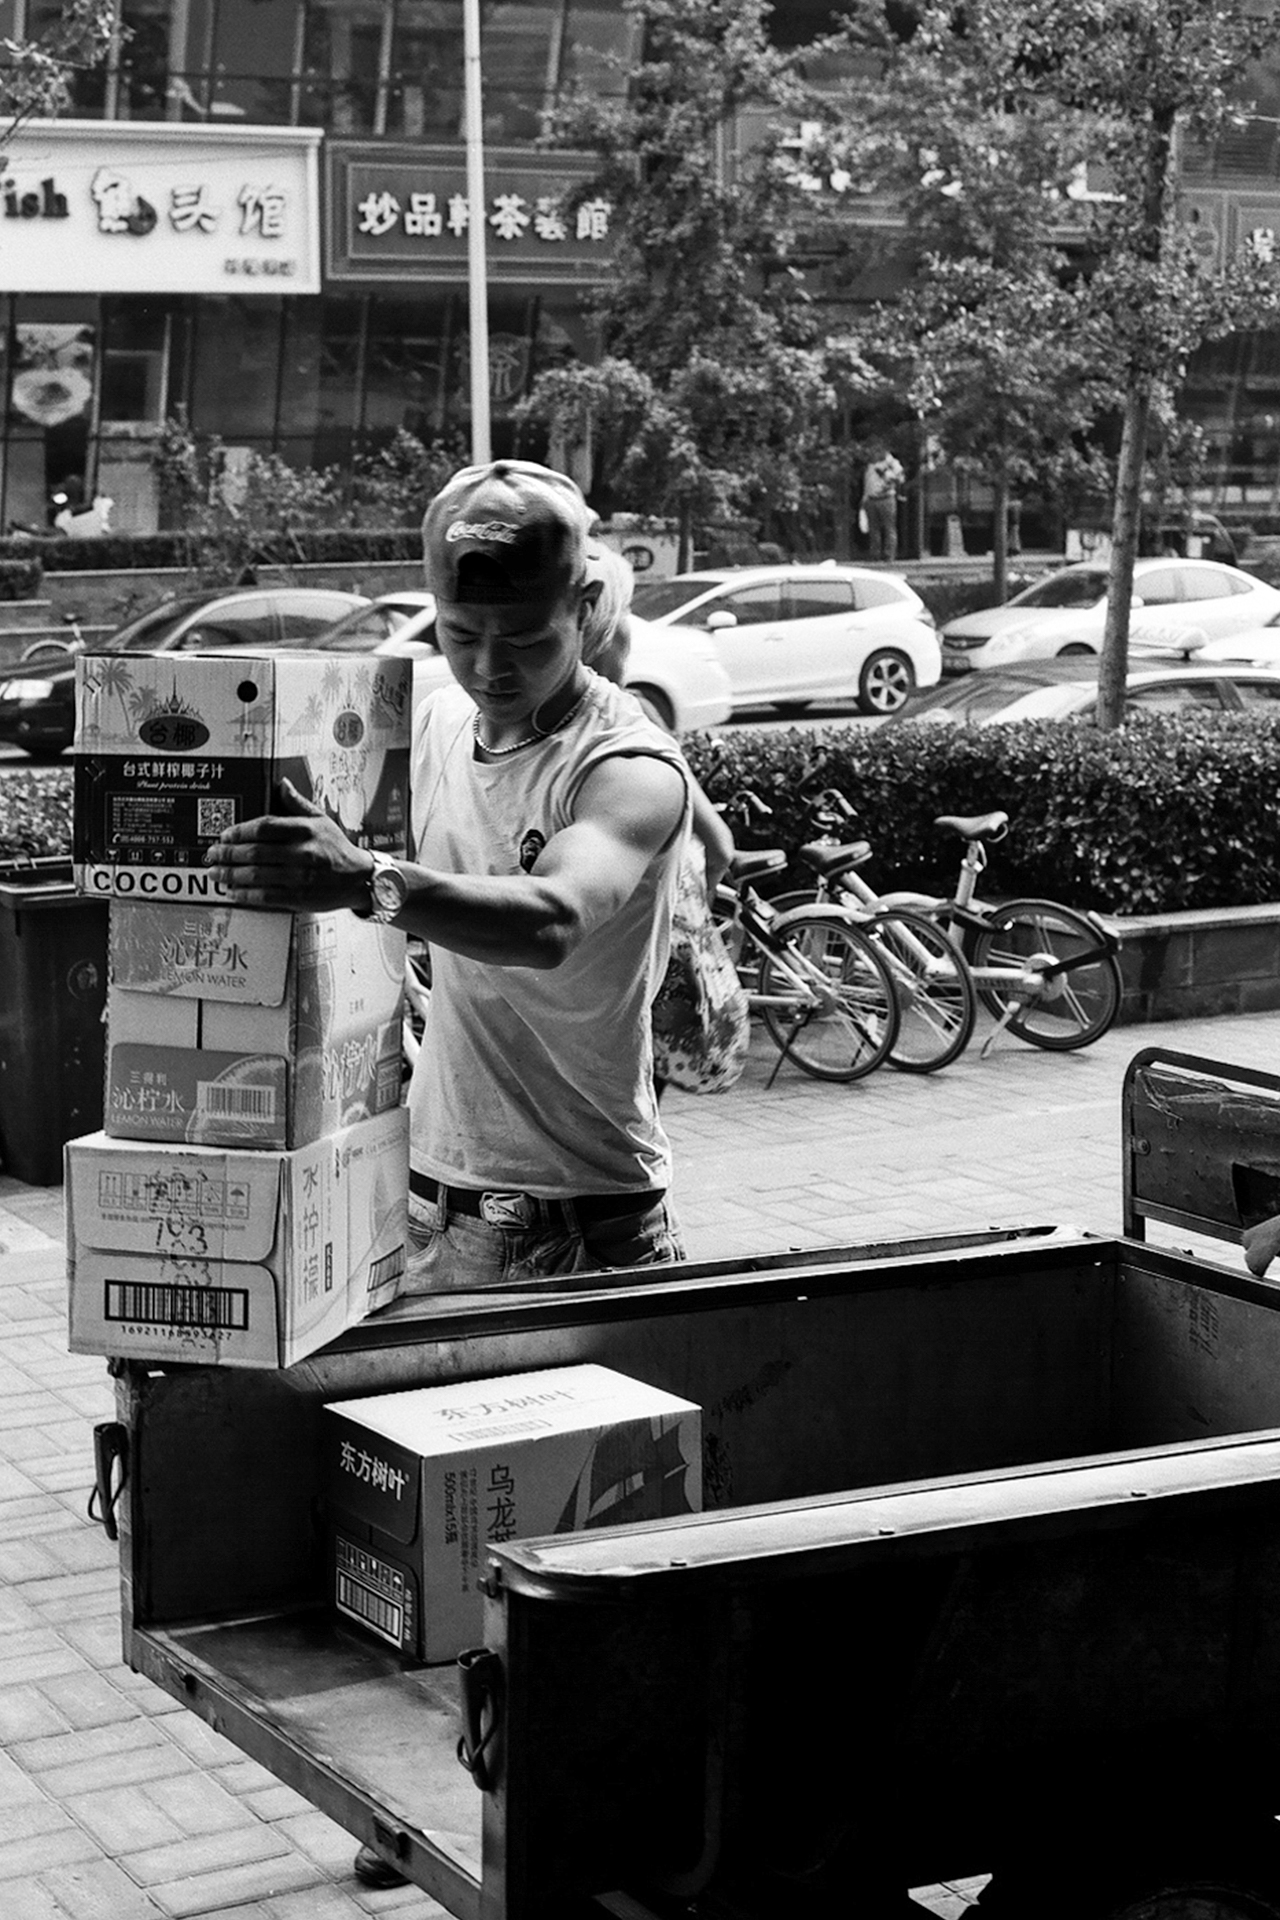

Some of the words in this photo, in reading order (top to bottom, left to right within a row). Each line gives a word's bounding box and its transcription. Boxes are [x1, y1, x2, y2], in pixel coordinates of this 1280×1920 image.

[0, 175, 69, 218] ish
[161, 968, 203, 984] LEMON
[206, 973, 247, 988] WATER
[110, 1113, 149, 1126] LEMON
[150, 1115, 184, 1127] WATER
[340, 1440, 406, 1501] 东方树叶
